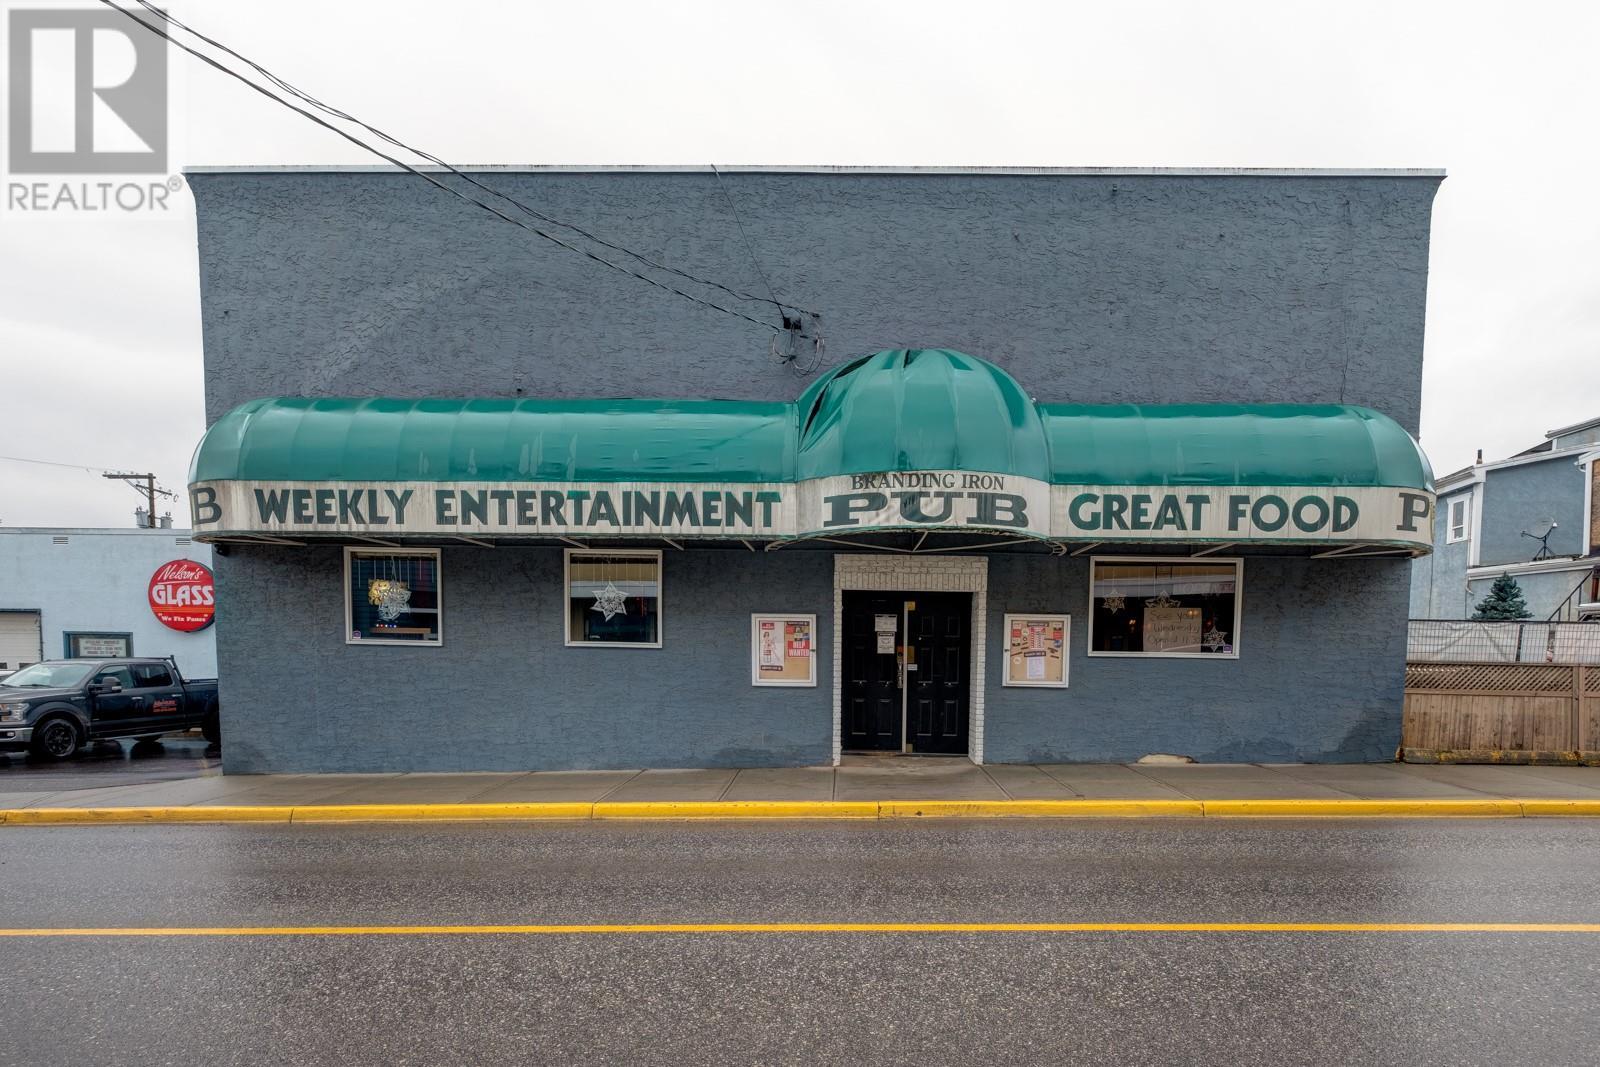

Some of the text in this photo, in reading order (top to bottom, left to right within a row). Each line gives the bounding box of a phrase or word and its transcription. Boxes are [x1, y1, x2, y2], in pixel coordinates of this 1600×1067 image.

[852, 473, 1004, 490] BRANDING IRON
[254, 488, 781, 528] WEEKLY ENTERTAINMENT
[823, 491, 1029, 528] PUB
[1068, 493, 1359, 532] GREAT FOOD
[157, 564, 204, 581] Nelson's
[152, 584, 215, 607] GLASS
